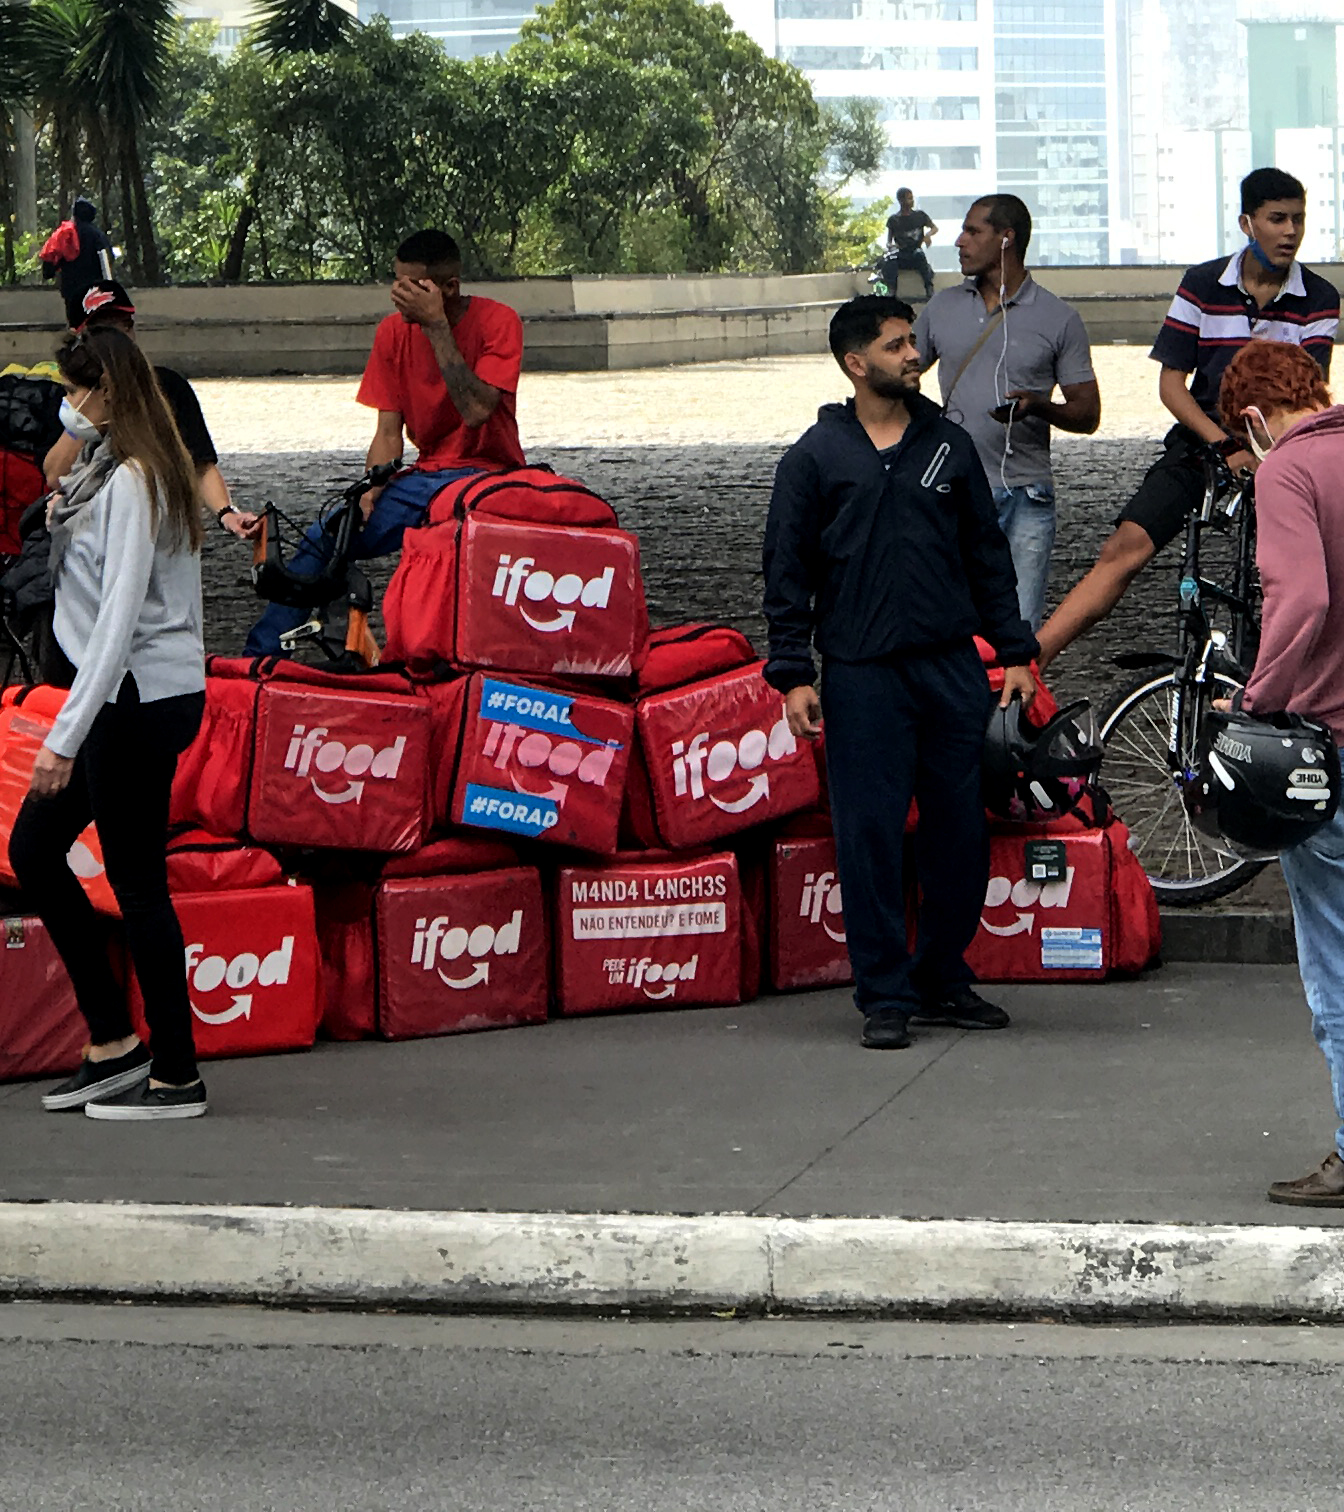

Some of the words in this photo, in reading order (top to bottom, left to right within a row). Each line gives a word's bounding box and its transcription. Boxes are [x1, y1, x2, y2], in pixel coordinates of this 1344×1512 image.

[492, 554, 615, 608] ifood
[284, 724, 407, 779] ifood
[484, 722, 619, 787] ifood
[671, 702, 797, 801] ifood
[1295, 772, 1324, 785] YOHE
[572, 880, 640, 903] M4ND4
[643, 874, 727, 901] L4NCH3S
[799, 871, 844, 923] ifo
[411, 910, 523, 970] ifood
[608, 913, 675, 930] ENTENDEU?
[688, 910, 720, 926] FOME
[185, 935, 295, 993] food
[626, 953, 699, 989] ifood
